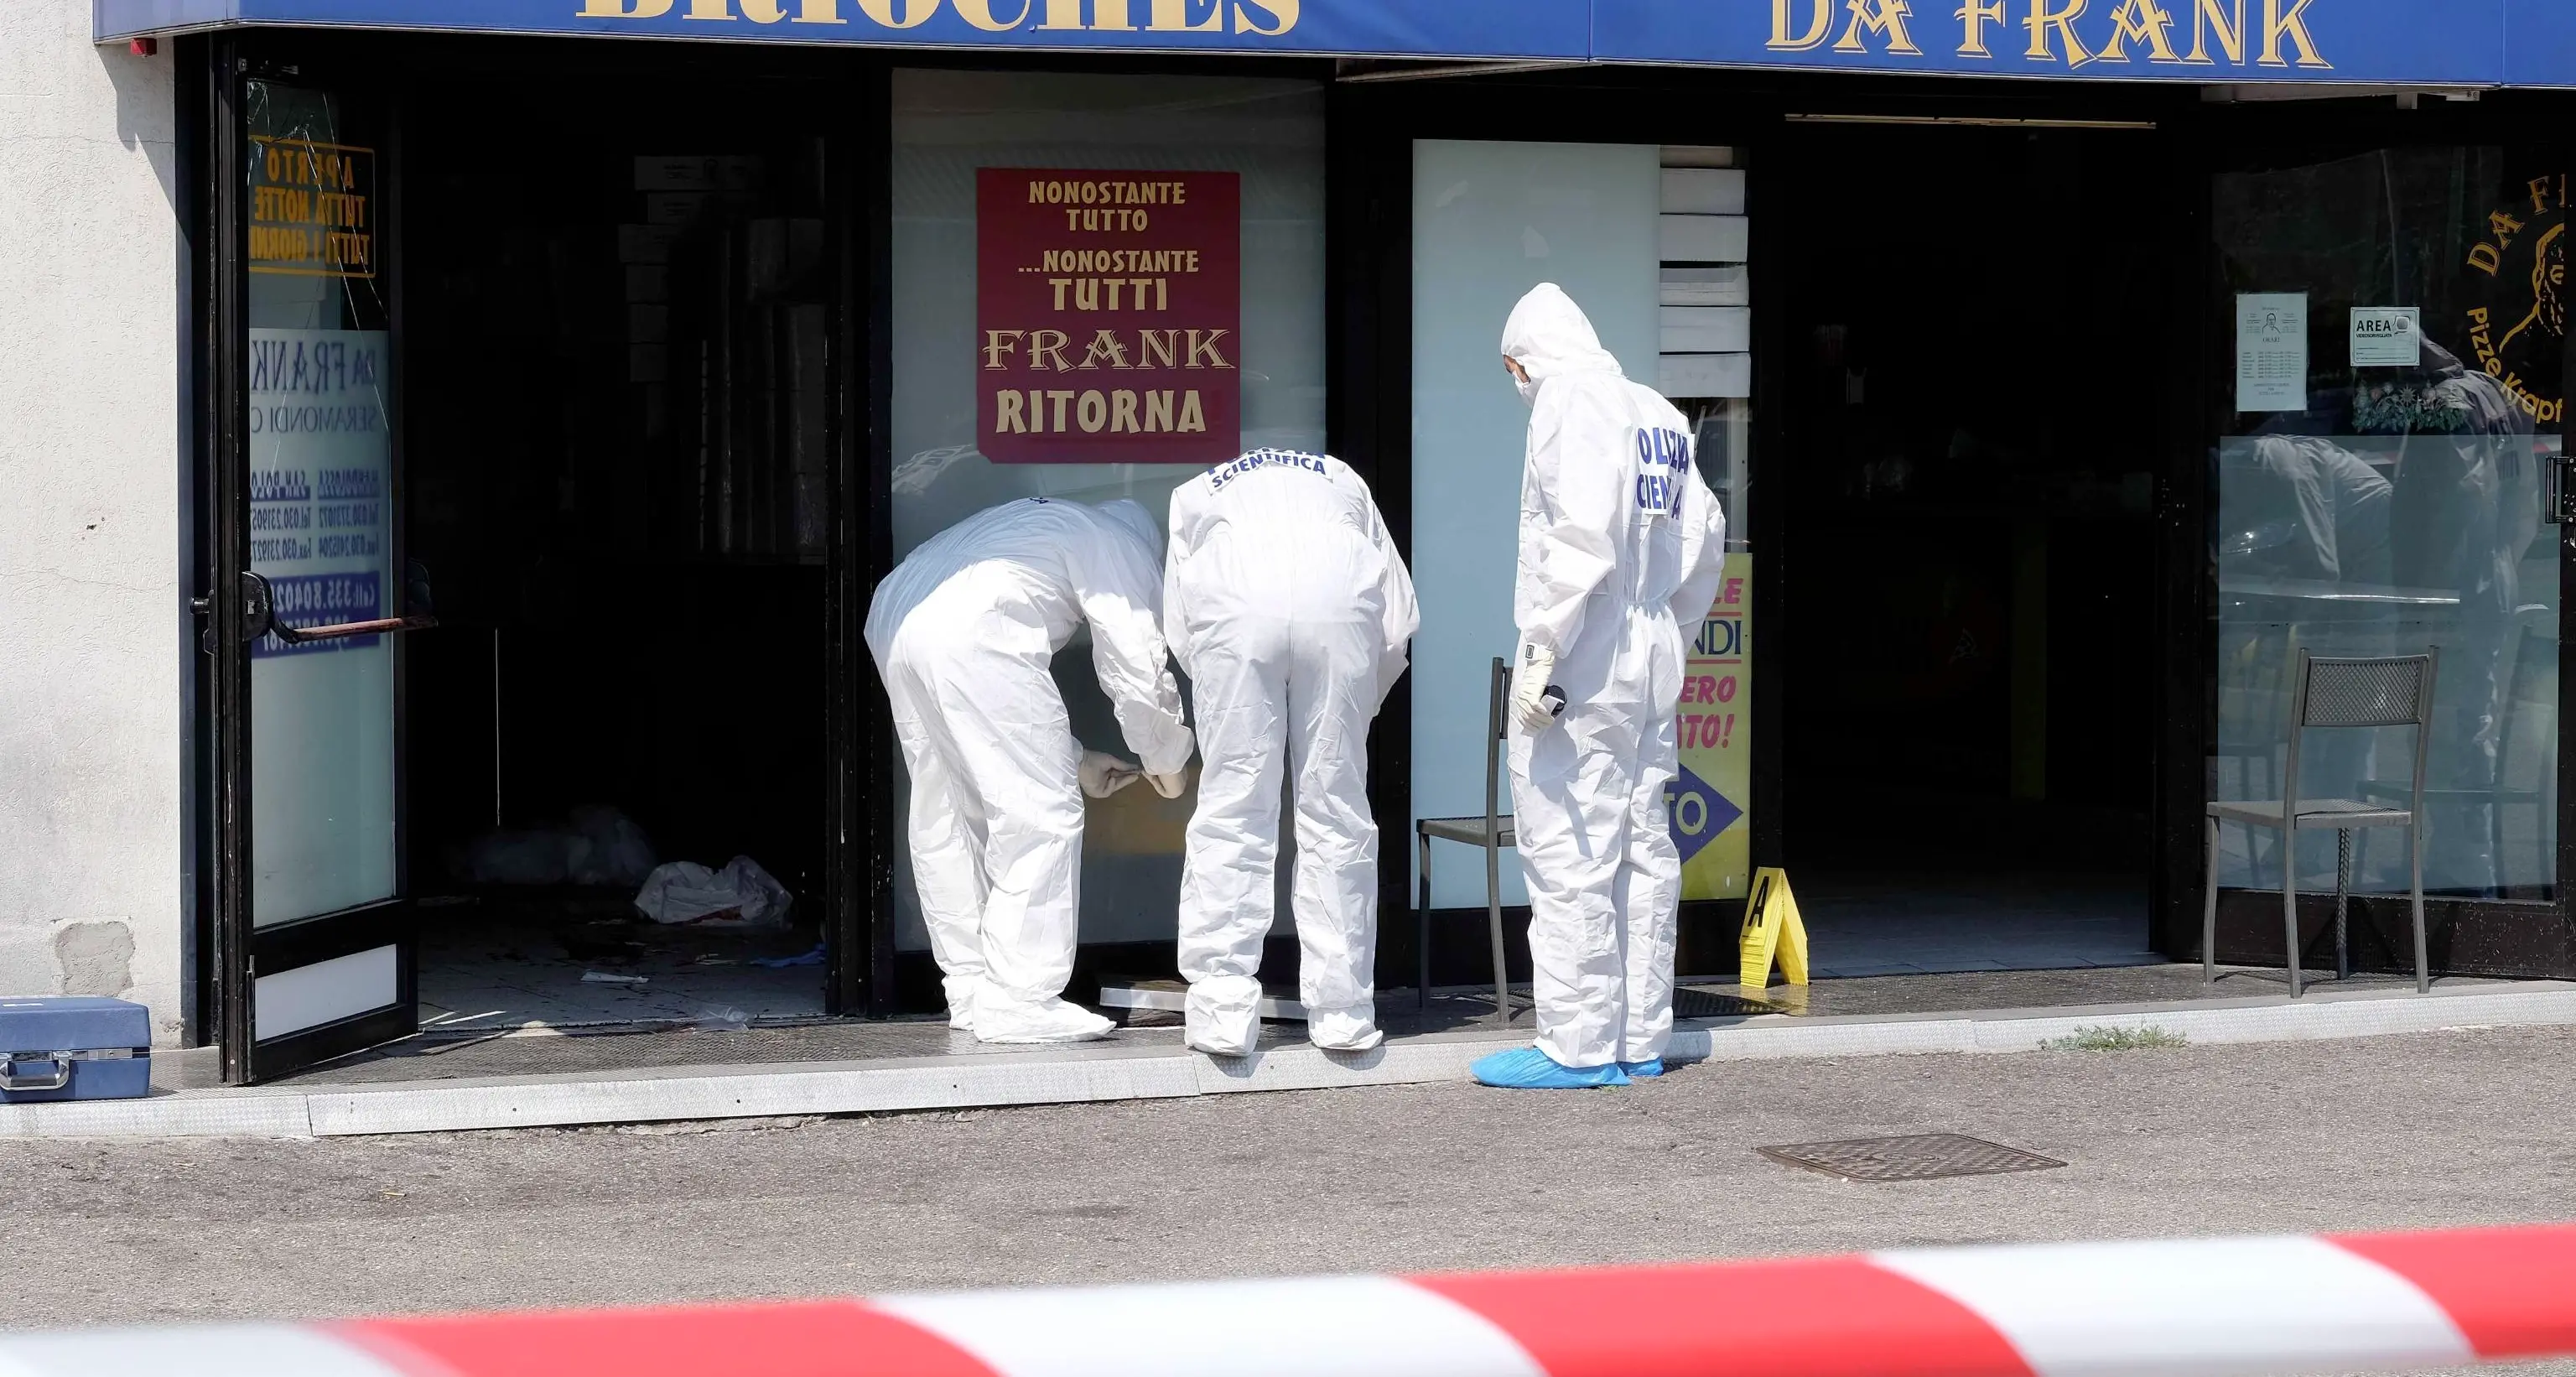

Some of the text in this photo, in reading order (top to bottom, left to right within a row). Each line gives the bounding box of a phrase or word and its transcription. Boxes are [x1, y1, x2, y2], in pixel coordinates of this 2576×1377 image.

[1764, 0, 2334, 70] DA FRANK
[1029, 181, 1186, 204] NONOSTANTE
[1066, 209, 1148, 231] TUTTO
[1018, 250, 1199, 273] ...NONOSTANTE
[2466, 208, 2525, 278] DA
[1048, 278, 1167, 311] TUTTI
[2355, 320, 2392, 331] AREA
[2466, 306, 2502, 377] Pizze
[982, 329, 1237, 374] FRANK
[995, 388, 1207, 434] RITORNA
[1747, 876, 1770, 928] A
